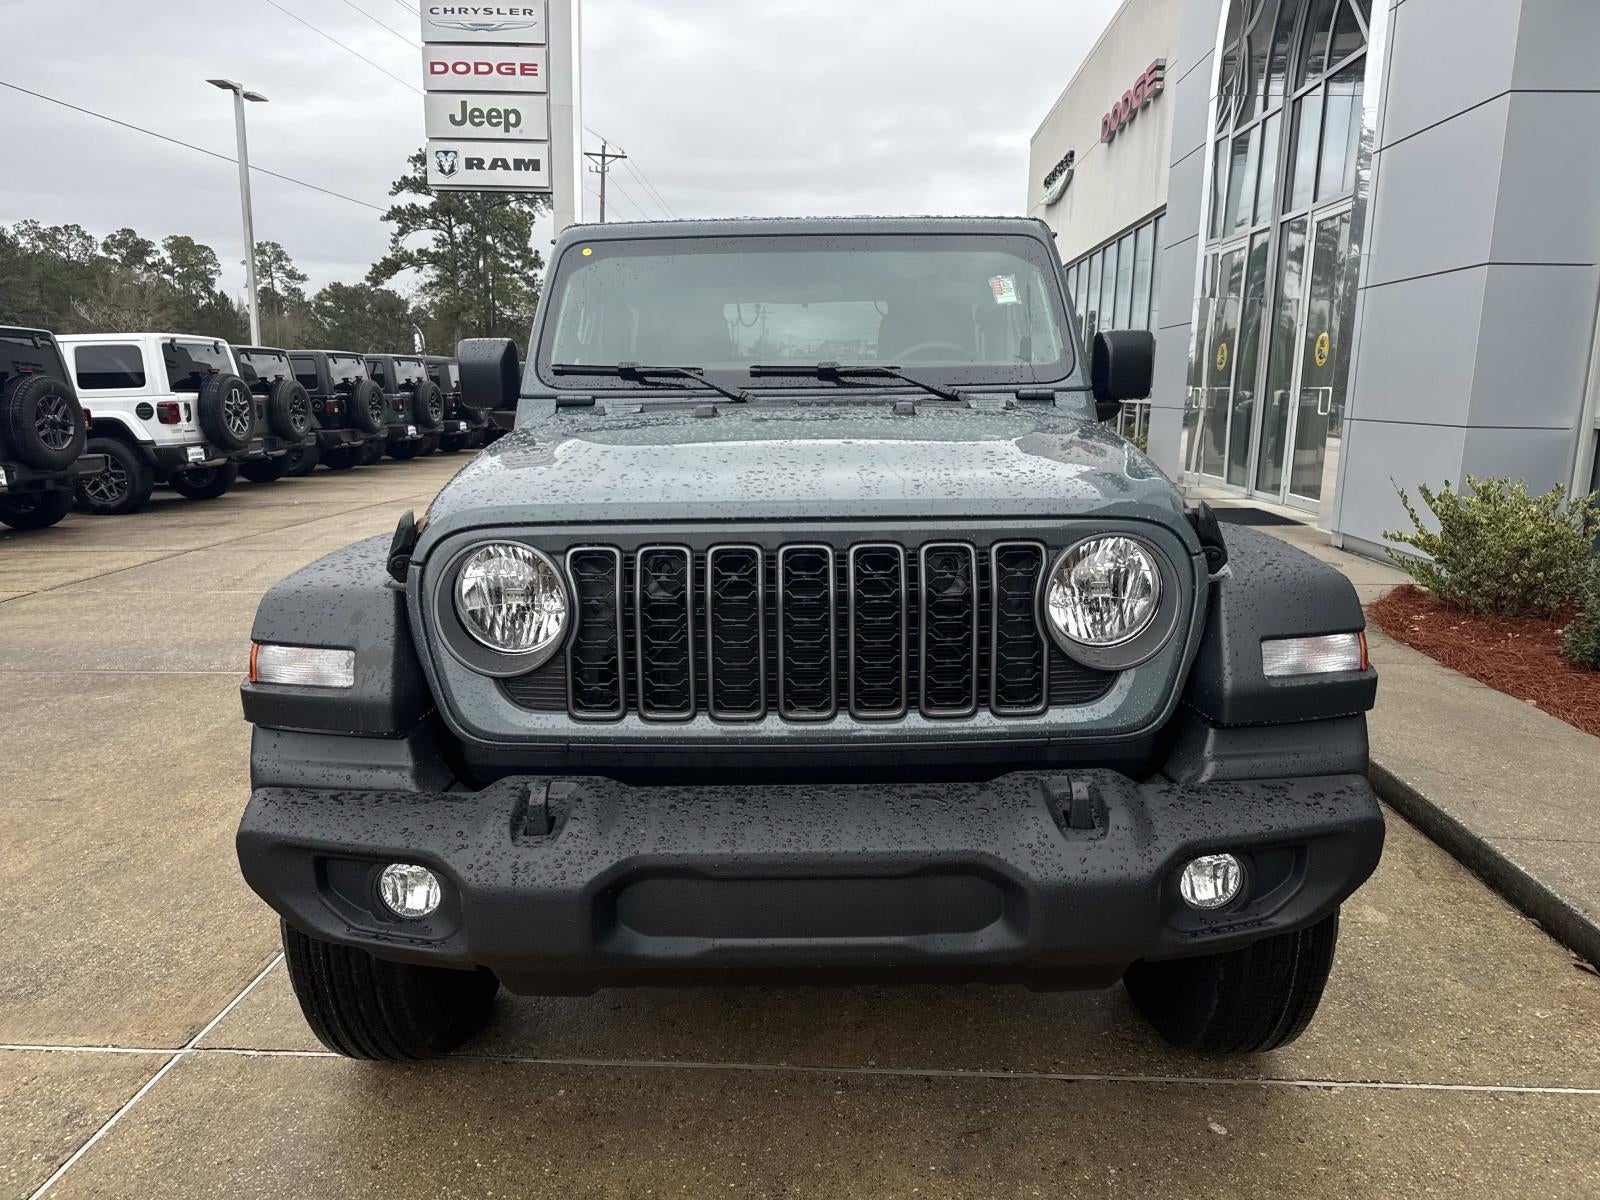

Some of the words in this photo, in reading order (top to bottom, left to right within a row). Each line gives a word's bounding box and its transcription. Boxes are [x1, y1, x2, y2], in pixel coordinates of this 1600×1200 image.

[429, 7, 534, 16] CHRYSLER
[429, 61, 539, 77] DODGE
[1100, 58, 1166, 143] DODGE
[449, 100, 522, 133] Jeep
[464, 157, 541, 171] RAM
